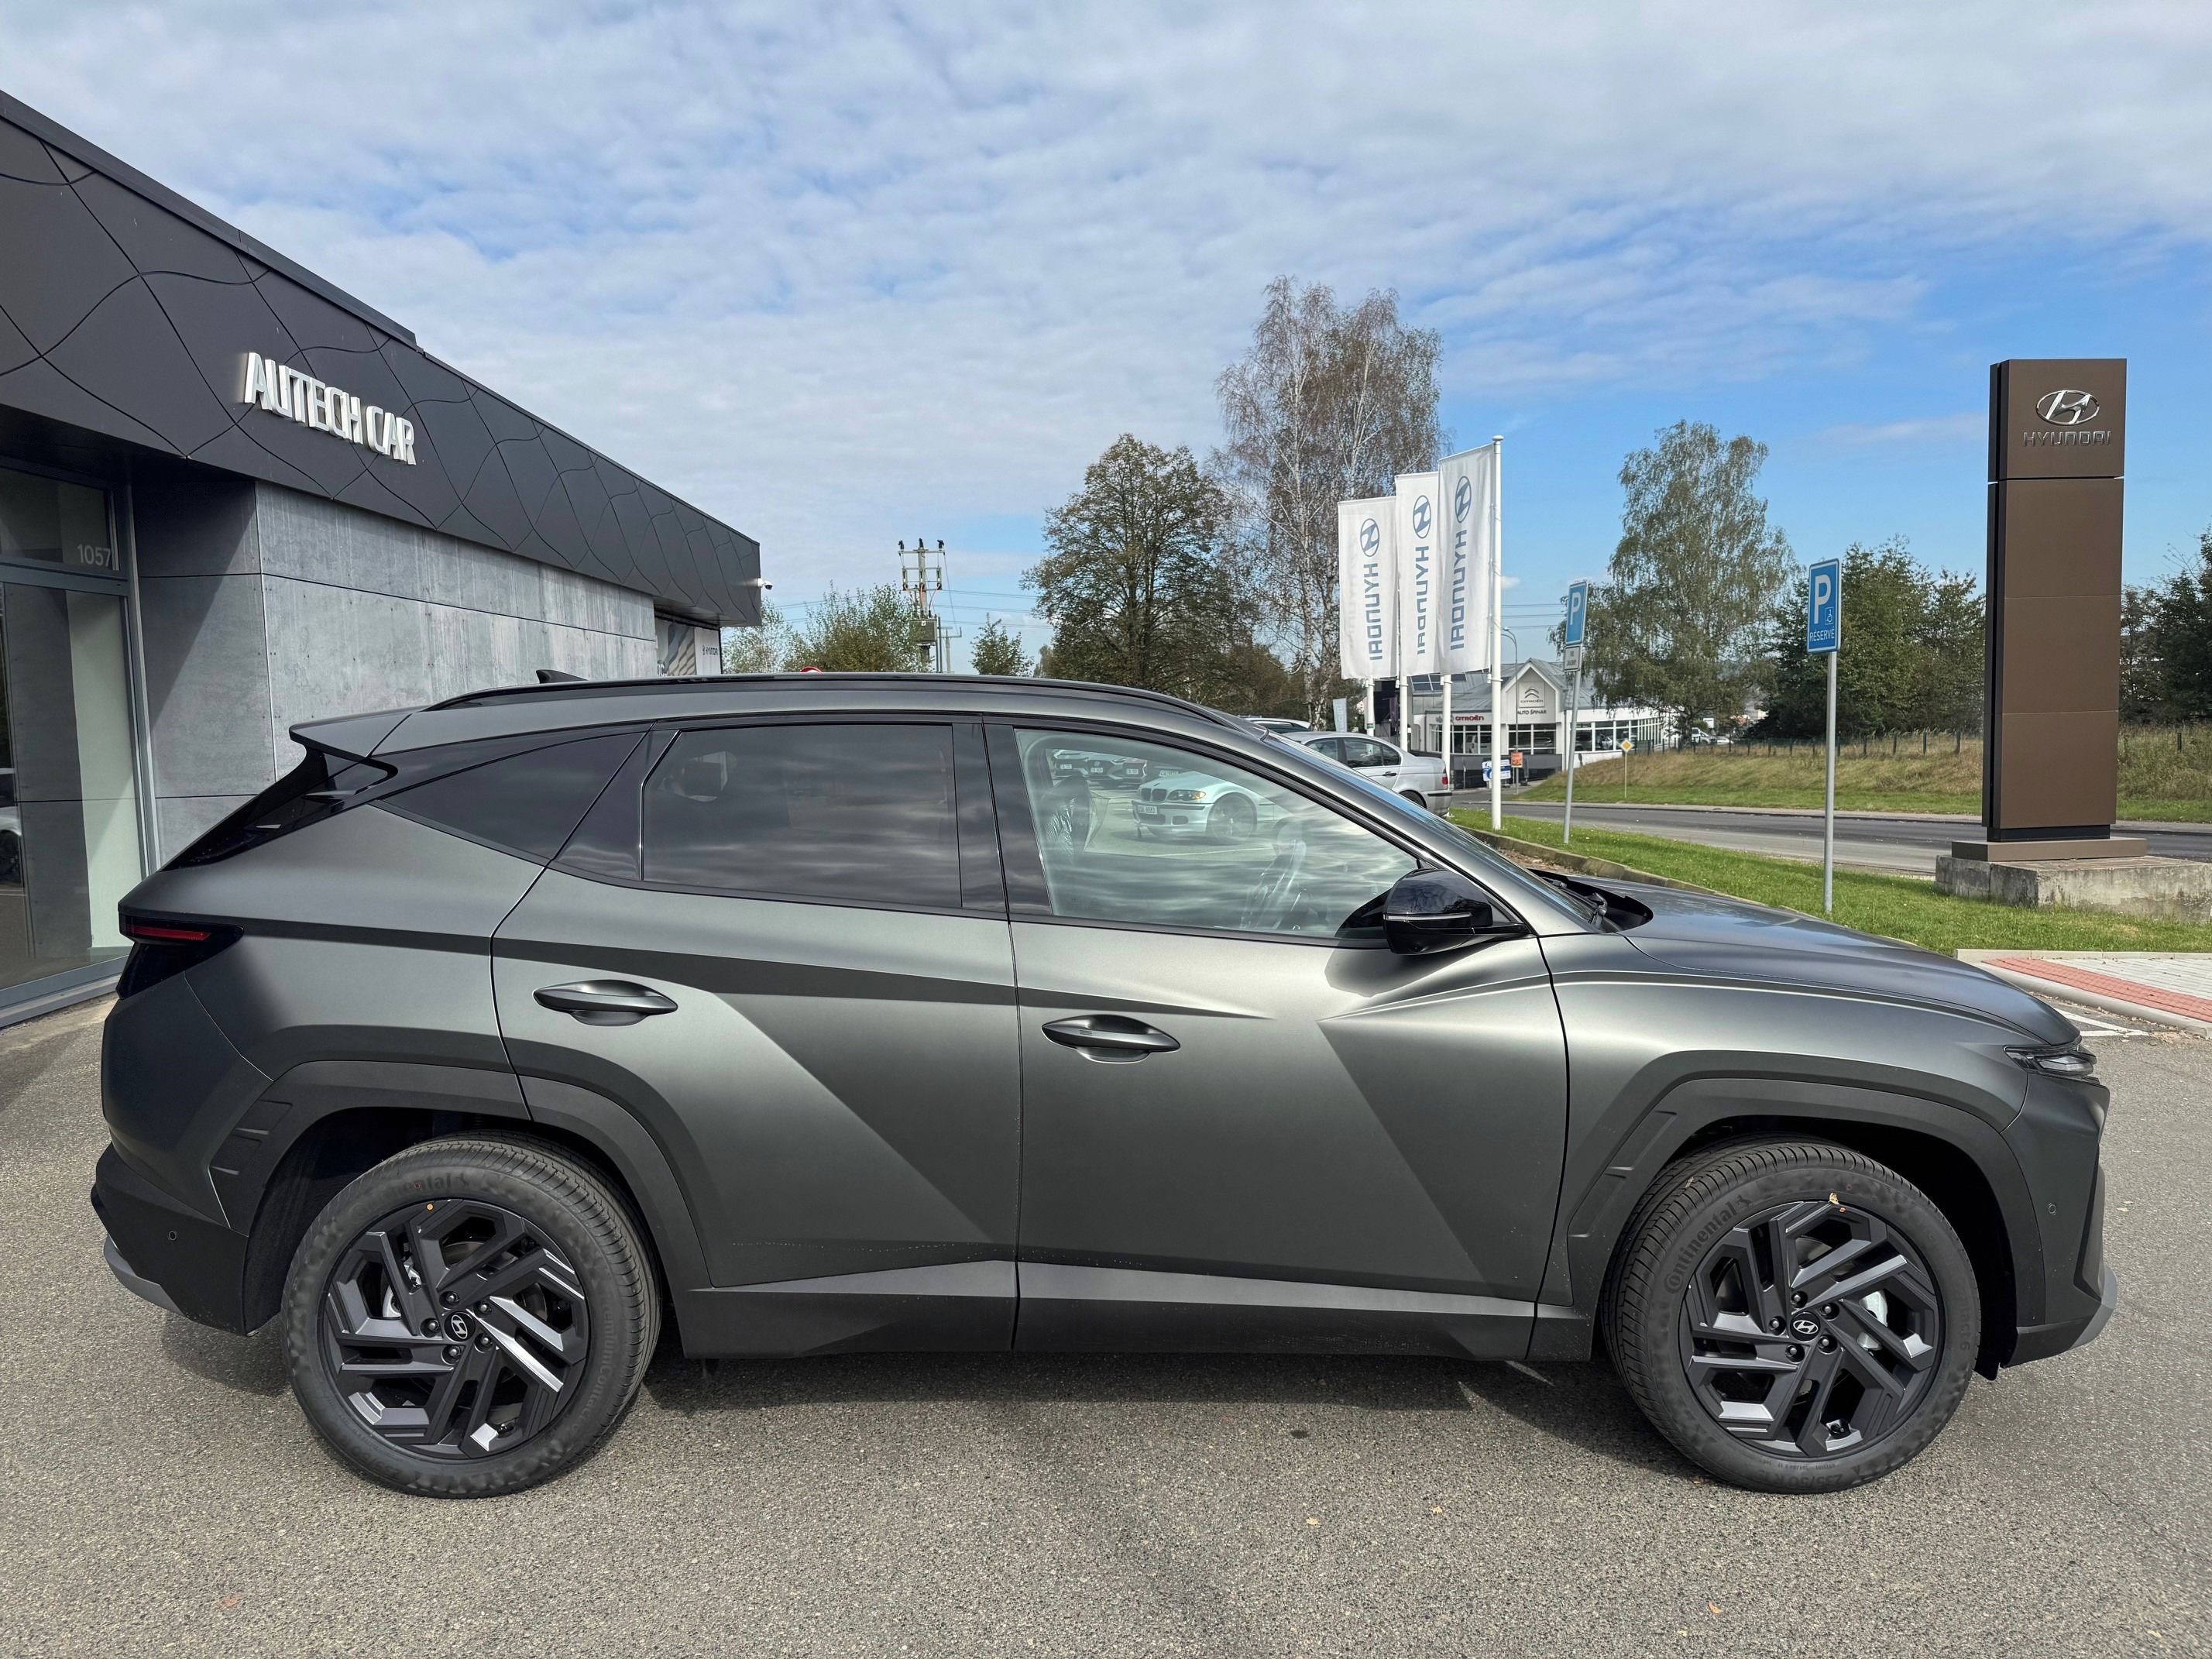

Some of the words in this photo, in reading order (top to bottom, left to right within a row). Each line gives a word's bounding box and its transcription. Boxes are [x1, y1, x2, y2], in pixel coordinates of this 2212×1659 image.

[244, 352, 363, 445] AUTECH
[366, 406, 417, 465] CAR
[2023, 431, 2111, 447] HYUNDAI
[77, 544, 111, 567] 1057
[1570, 592, 1581, 625] P
[1814, 574, 1831, 624] P
[1663, 1201, 1737, 1293] Continental
